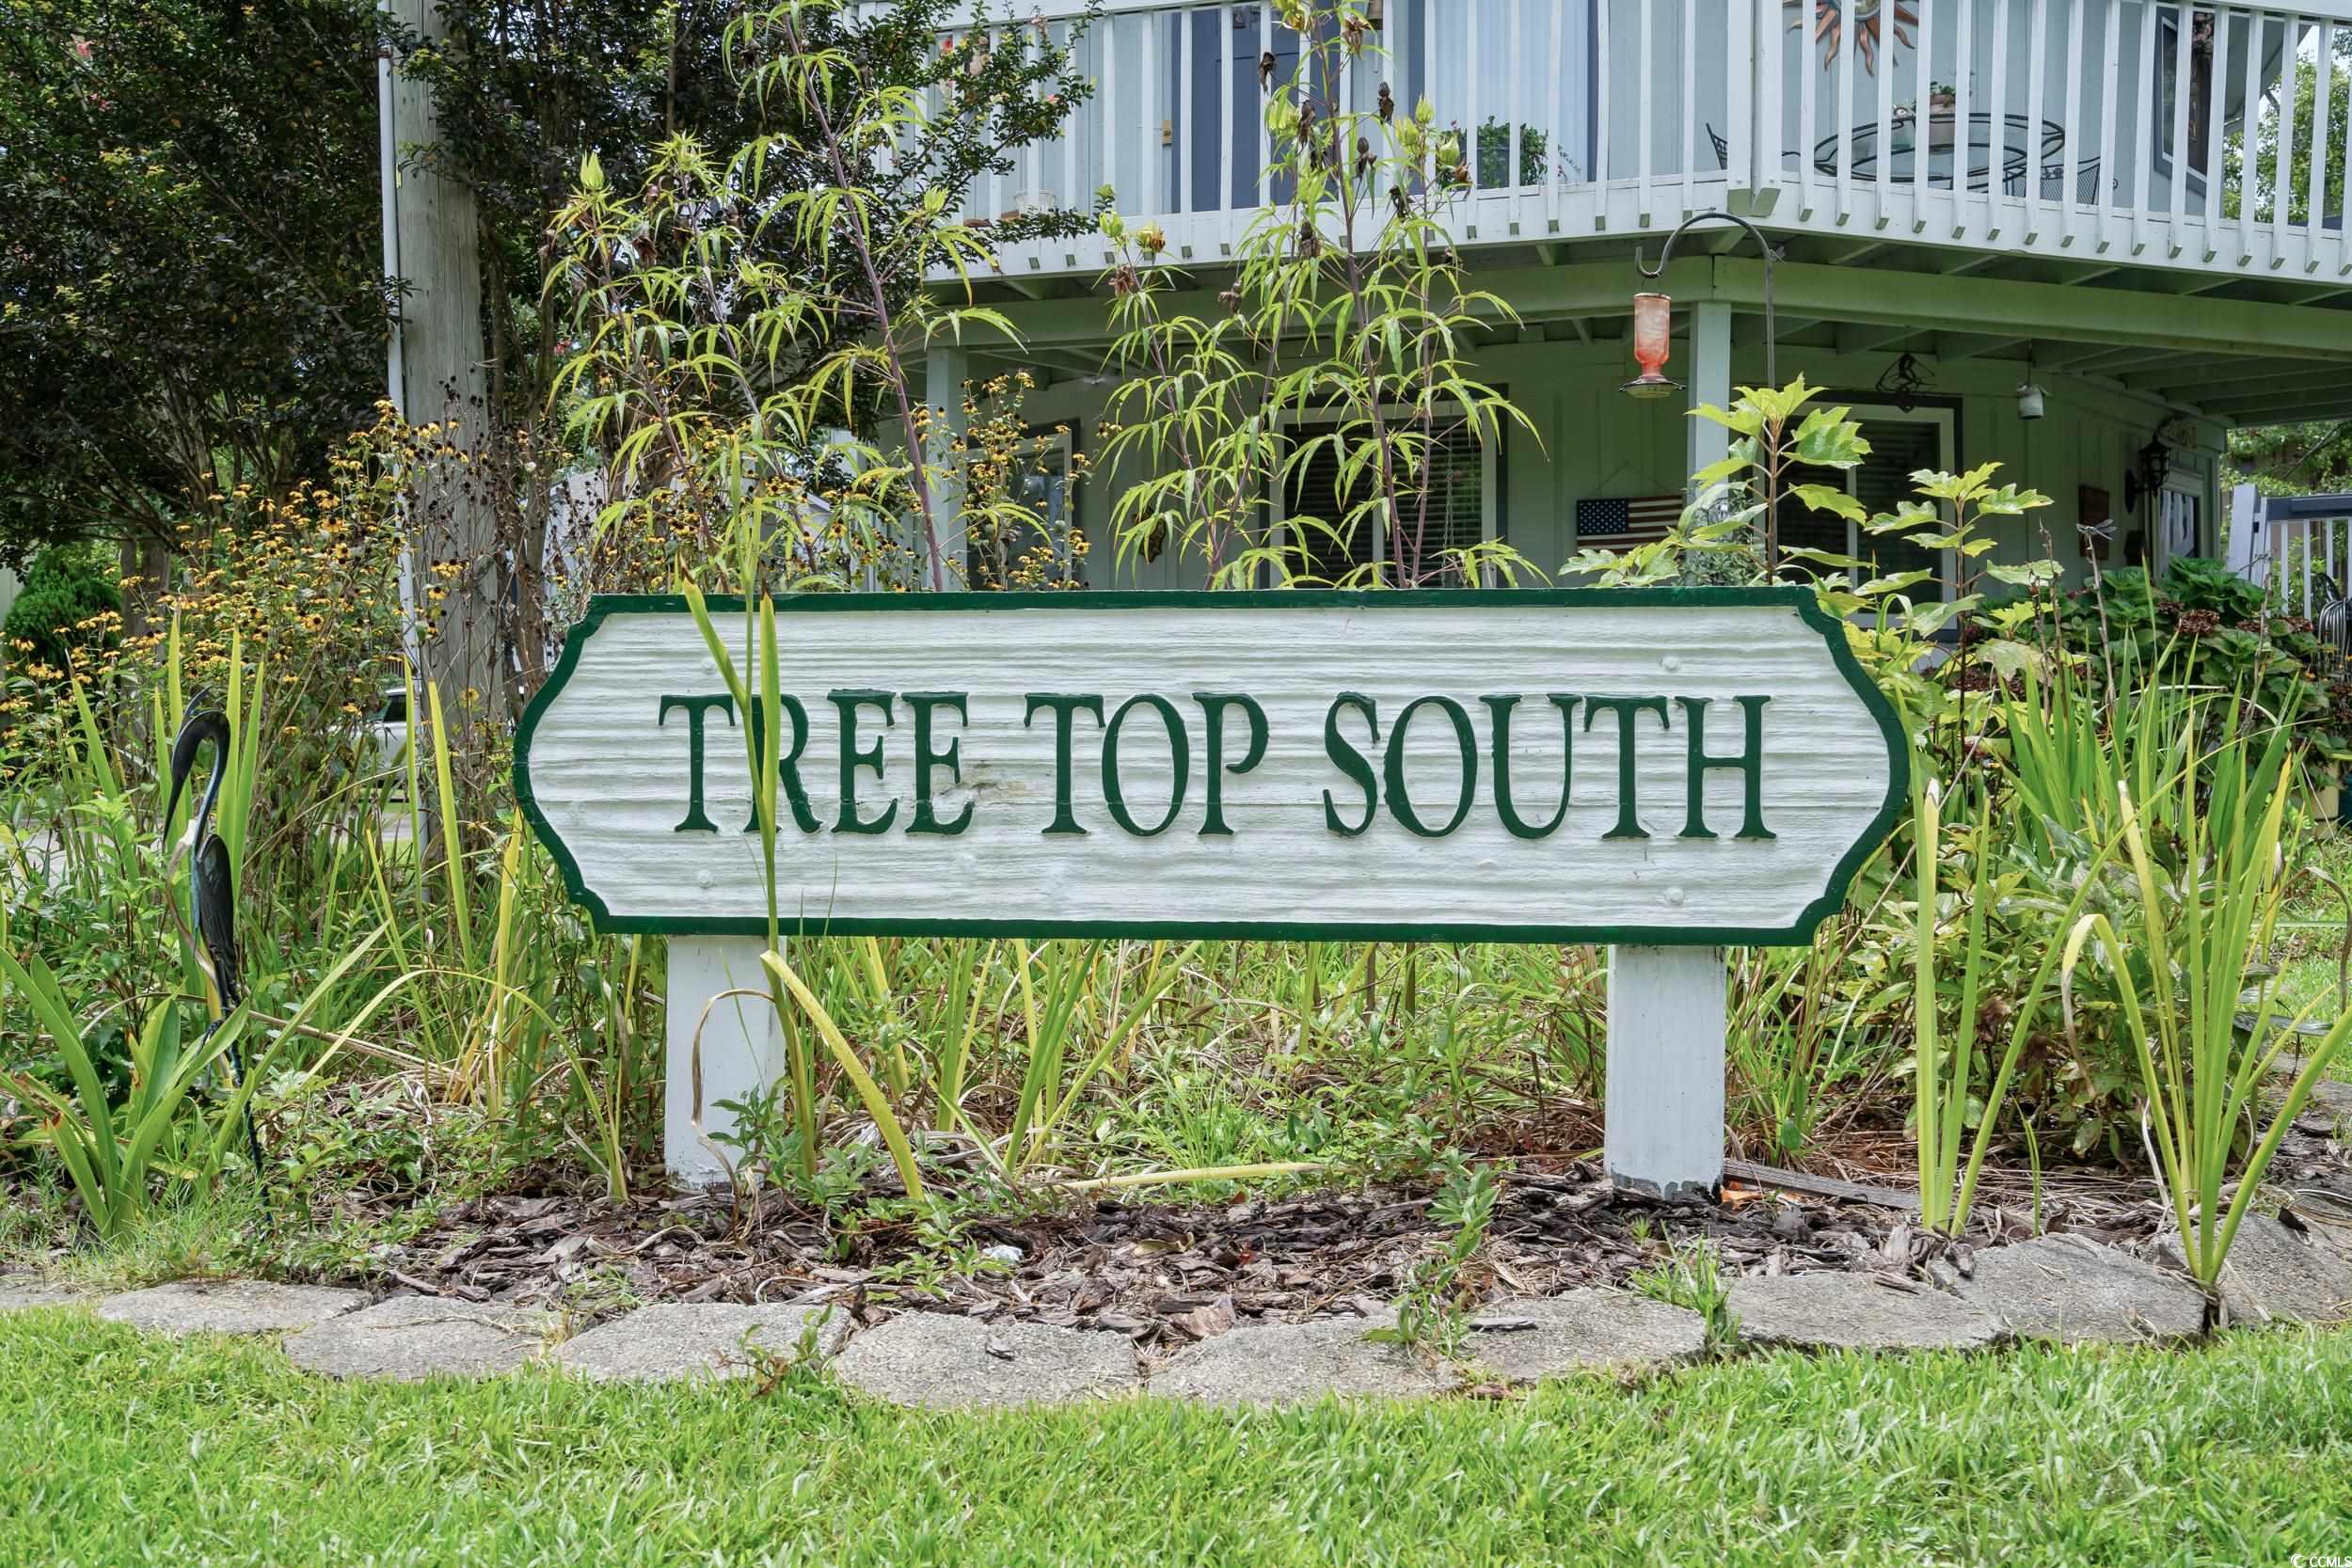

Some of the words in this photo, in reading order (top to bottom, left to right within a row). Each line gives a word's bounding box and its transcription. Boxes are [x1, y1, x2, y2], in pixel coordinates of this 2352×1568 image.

[659, 689, 975, 835] TREE
[1025, 691, 1269, 836] TOP
[1323, 691, 1777, 839] SOUTH
